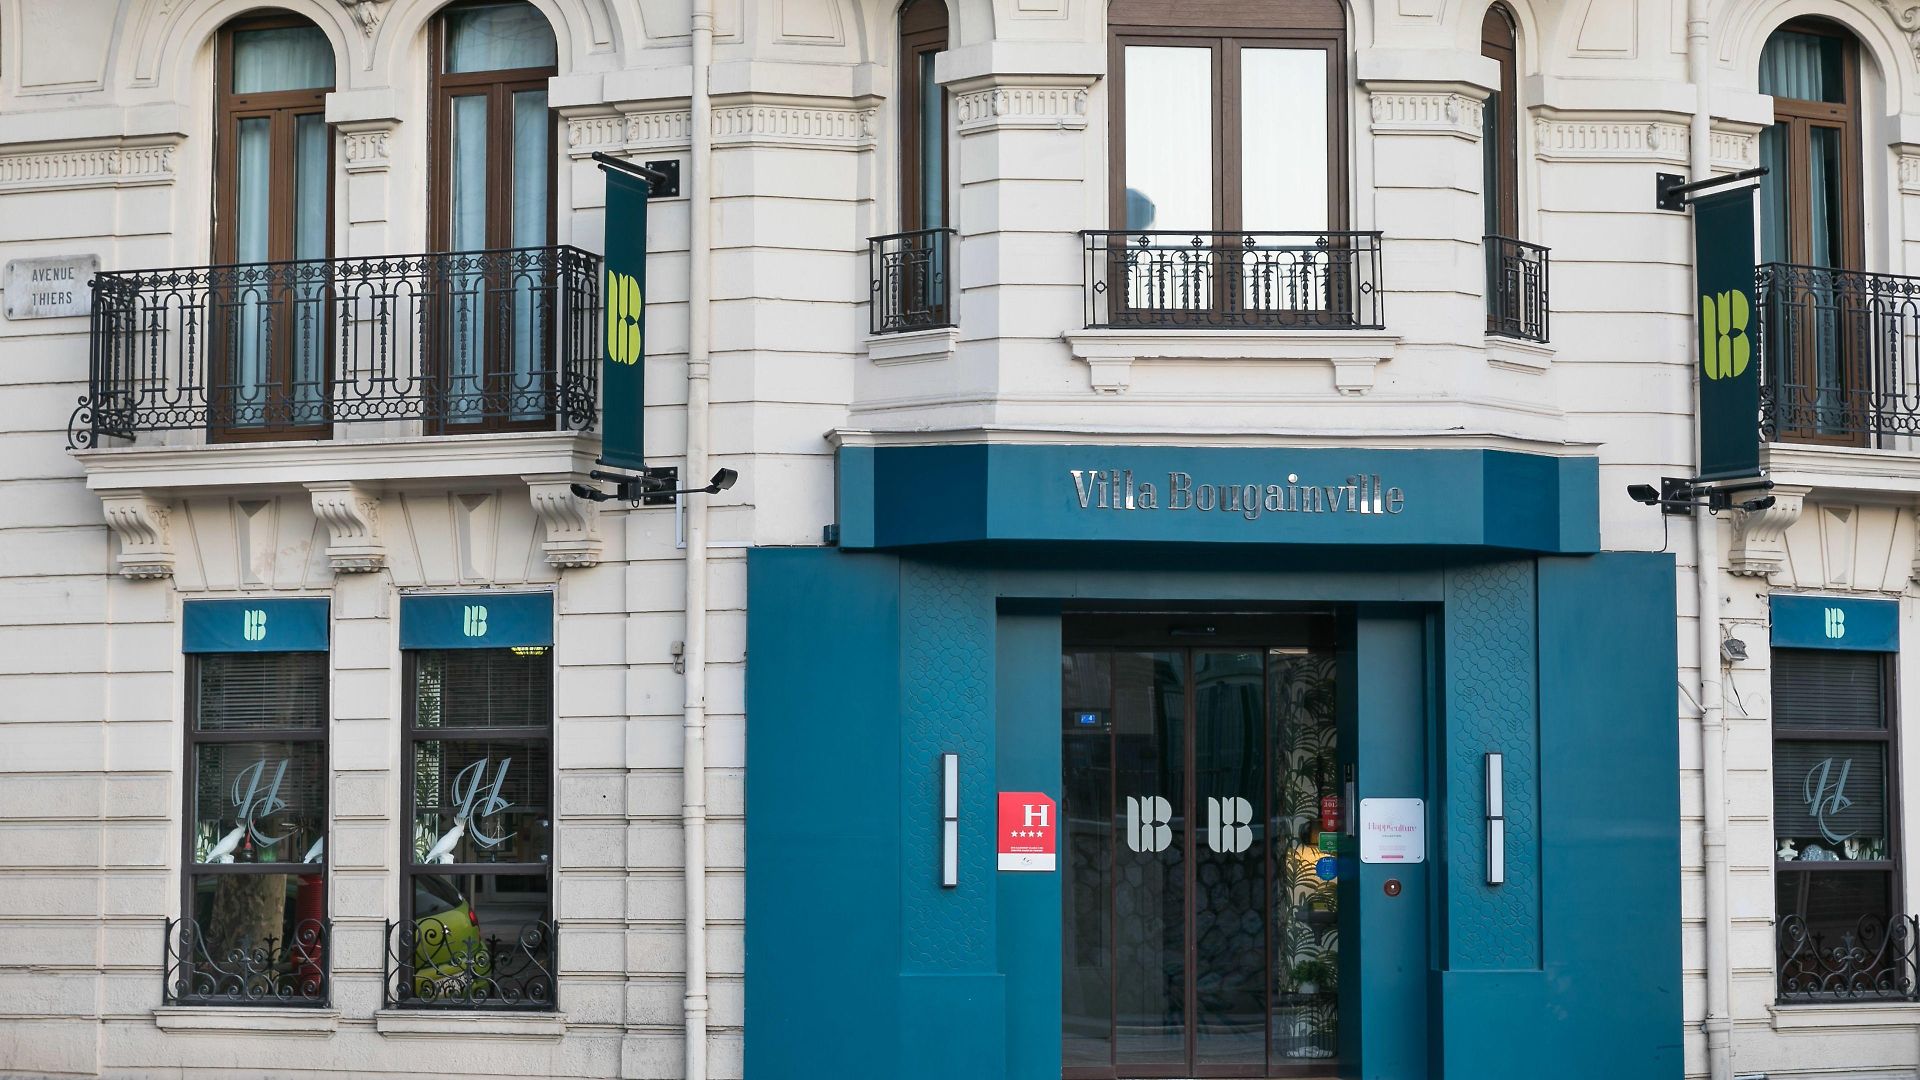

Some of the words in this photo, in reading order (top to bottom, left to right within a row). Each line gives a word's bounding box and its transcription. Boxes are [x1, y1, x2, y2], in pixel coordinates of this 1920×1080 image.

[32, 266, 75, 282] AVENUE
[32, 291, 73, 306] THIERS
[1070, 469, 1160, 510] Villa
[1168, 471, 1405, 520] Bougainville
[1023, 804, 1051, 827] H
